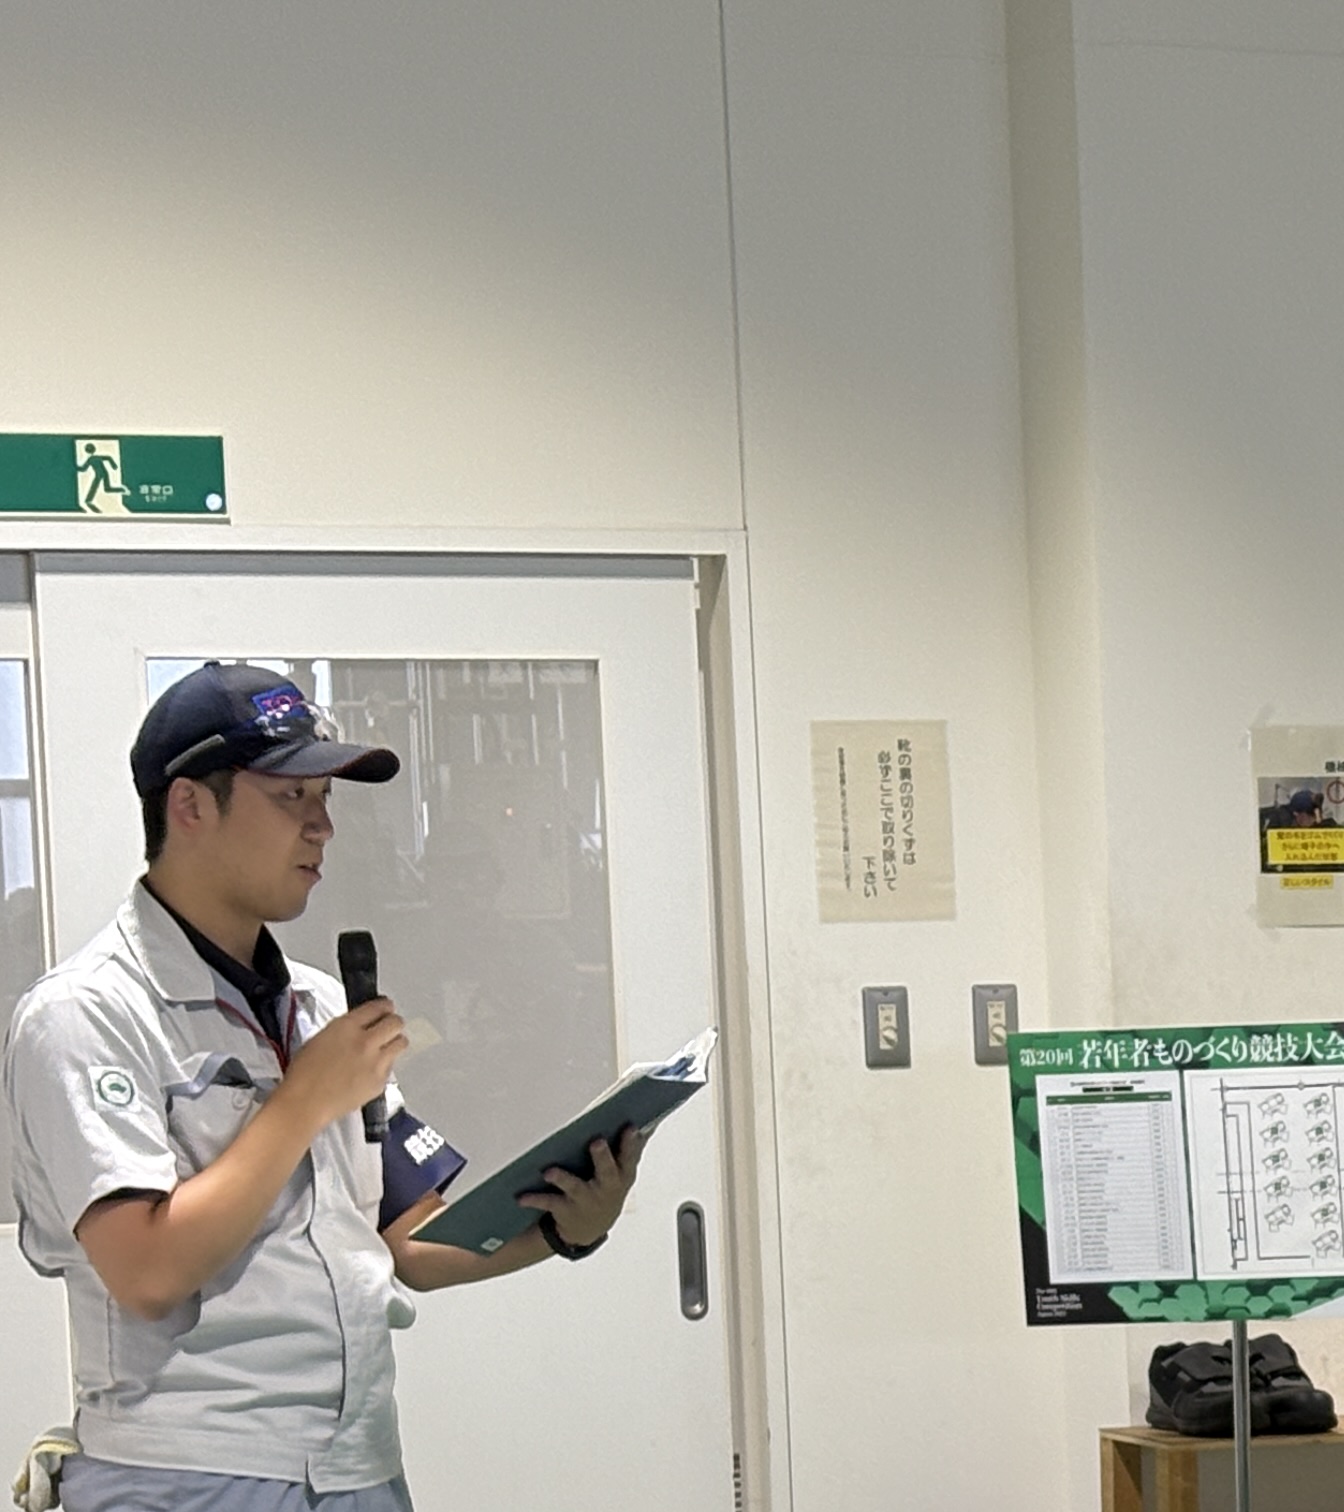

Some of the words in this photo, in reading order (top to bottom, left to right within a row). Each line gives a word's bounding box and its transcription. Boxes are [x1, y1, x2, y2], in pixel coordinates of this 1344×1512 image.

[877, 750, 897, 892] 必ずここで取り除いて
[862, 855, 878, 898] 下さい
[1019, 1048, 1073, 1068] 第20回
